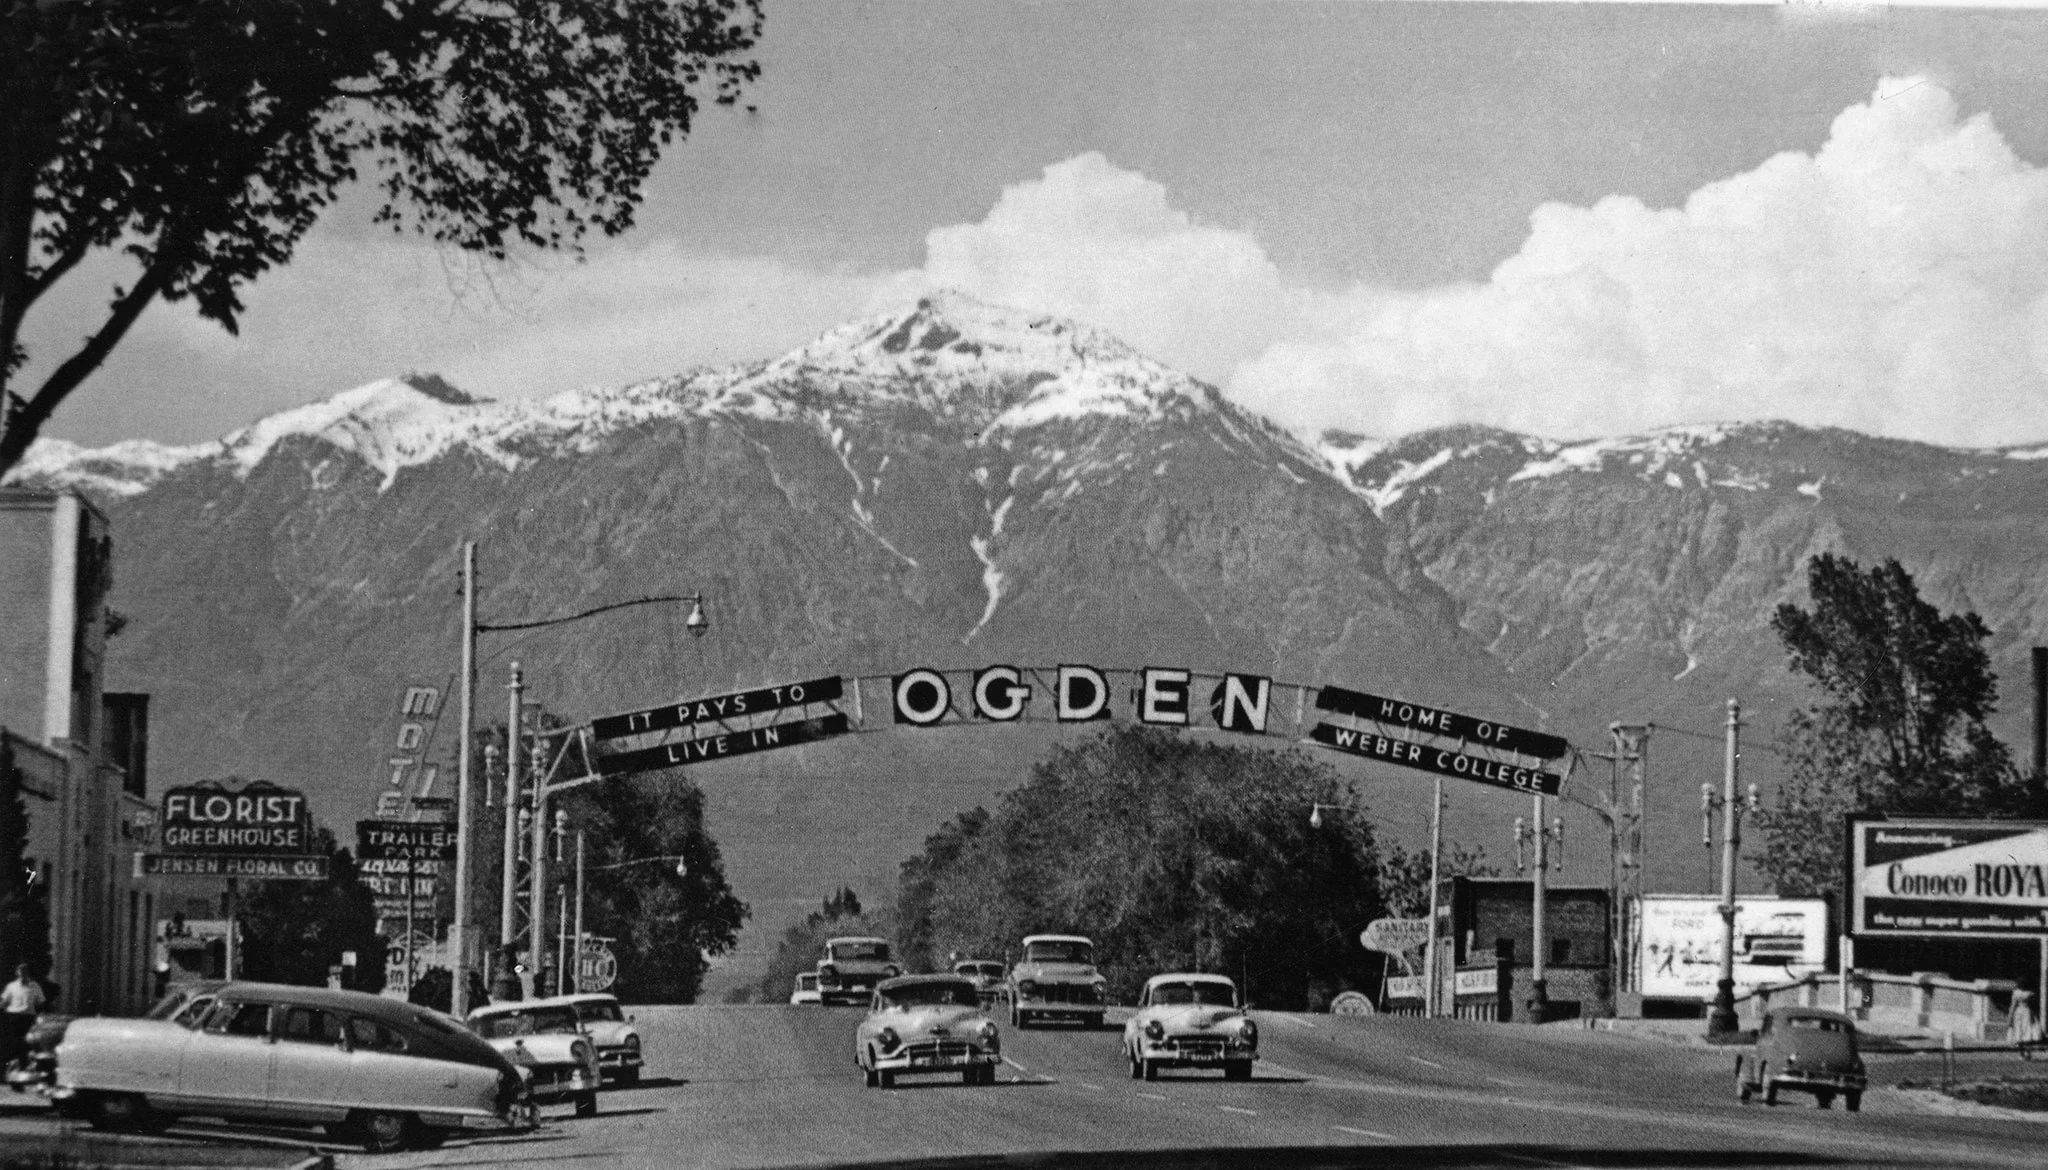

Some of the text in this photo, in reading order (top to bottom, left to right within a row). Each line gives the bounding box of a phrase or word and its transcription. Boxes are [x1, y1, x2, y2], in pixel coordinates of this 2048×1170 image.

[629, 685, 805, 731] IT PAYS TO
[897, 666, 1270, 732] OGDEN
[1380, 700, 1511, 743] HOME OF
[667, 728, 780, 763] LIVE IN
[1334, 728, 1545, 790] WEBER COLLEGE
[166, 795, 302, 824] FLORIST
[165, 827, 299, 847] GREENHOUSE
[384, 846, 442, 858] PARK
[148, 855, 320, 876] JENSEN FLORAL CO.
[1887, 861, 1968, 897] Conoco
